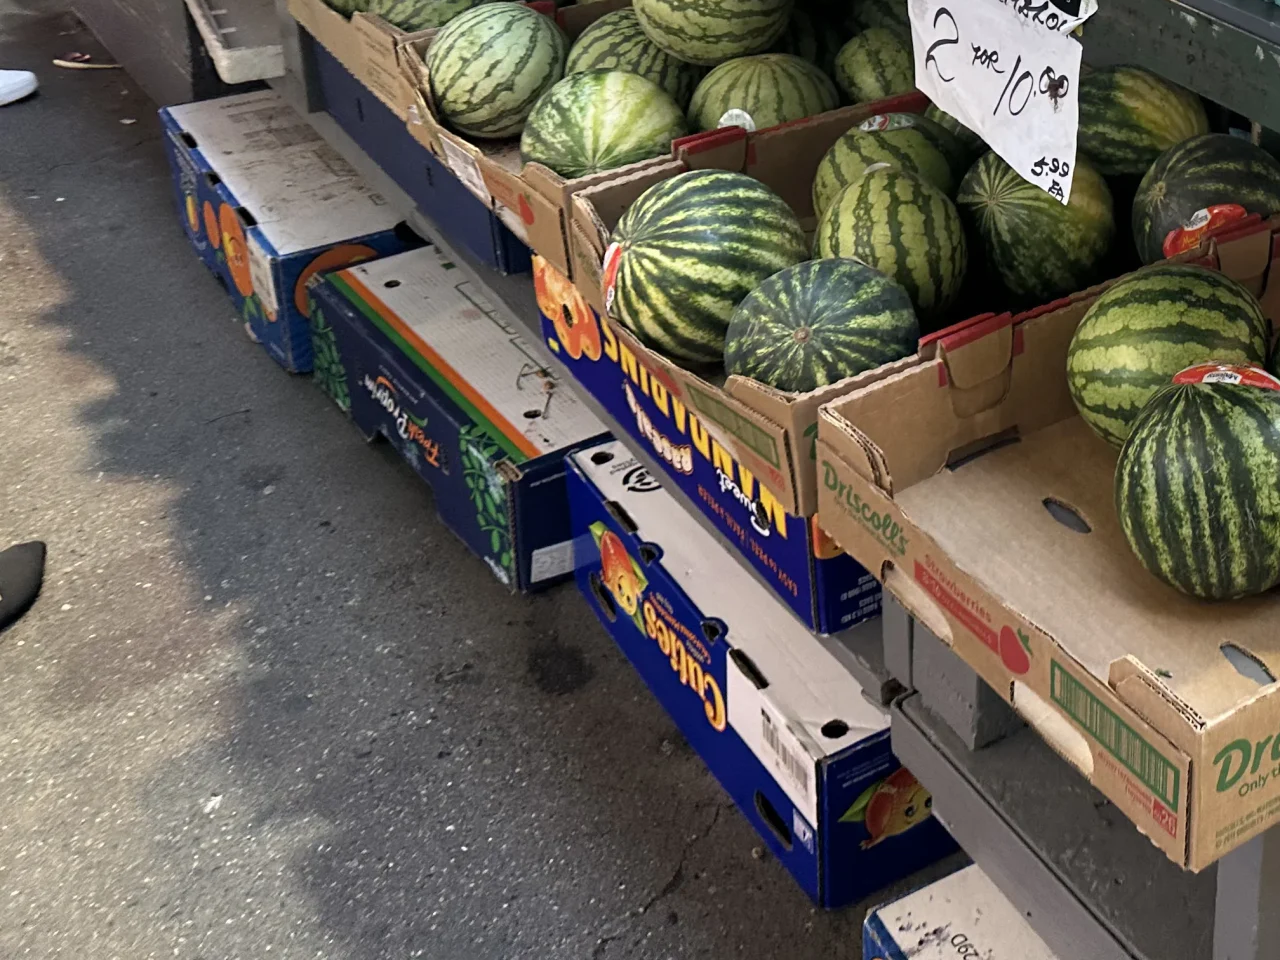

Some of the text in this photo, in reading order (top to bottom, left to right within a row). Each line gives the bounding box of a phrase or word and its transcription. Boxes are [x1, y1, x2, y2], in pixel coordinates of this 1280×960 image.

[925, 7, 959, 82] 2
[1031, 156, 1070, 179] 5.99
[821, 459, 908, 557] Driscoll's
[643, 598, 728, 733] Cuties
[1238, 768, 1270, 798] Only
